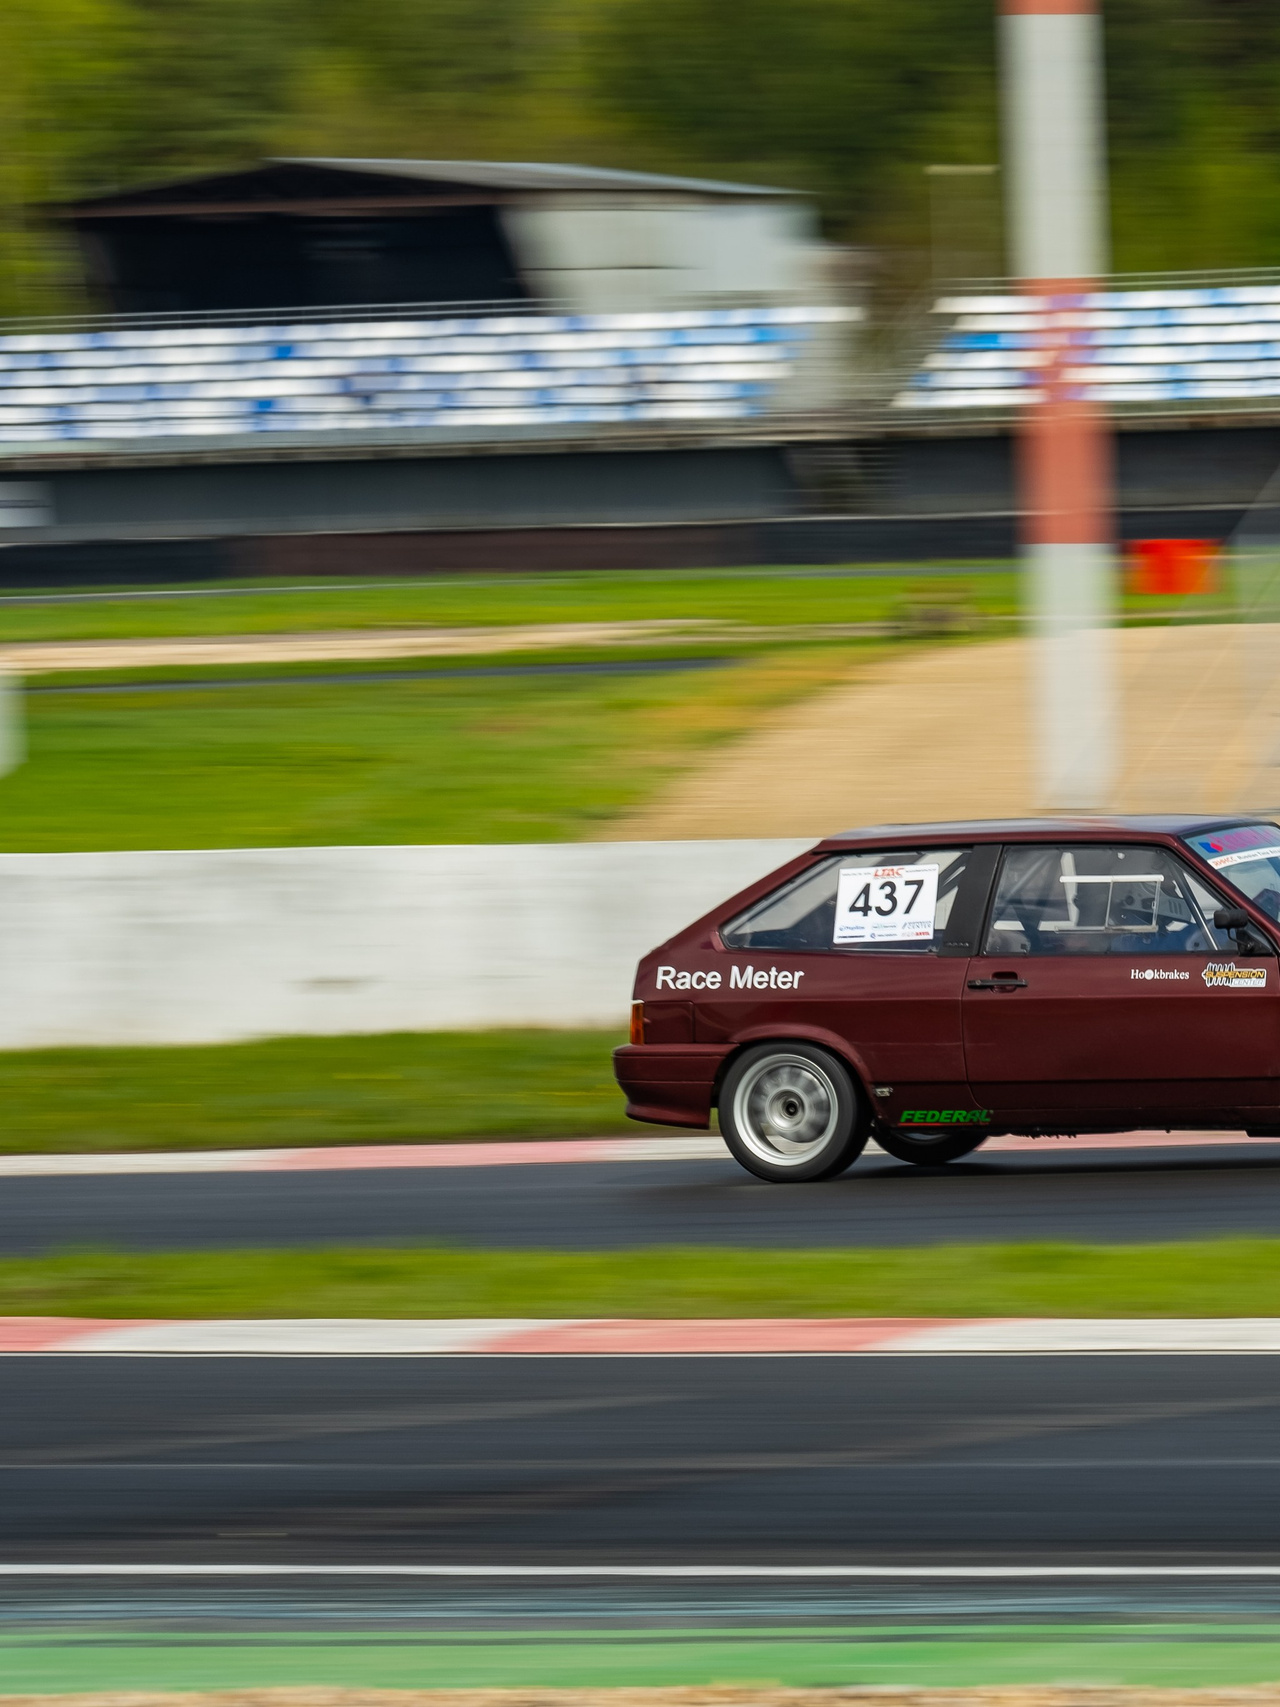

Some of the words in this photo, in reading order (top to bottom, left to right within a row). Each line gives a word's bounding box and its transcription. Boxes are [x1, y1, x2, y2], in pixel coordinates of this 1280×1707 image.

[849, 879, 925, 917] 437
[656, 965, 722, 990] Race
[729, 965, 805, 990] Meter
[1205, 970, 1265, 979] SUSPENSION
[900, 1110, 991, 1122] FEDERAL
